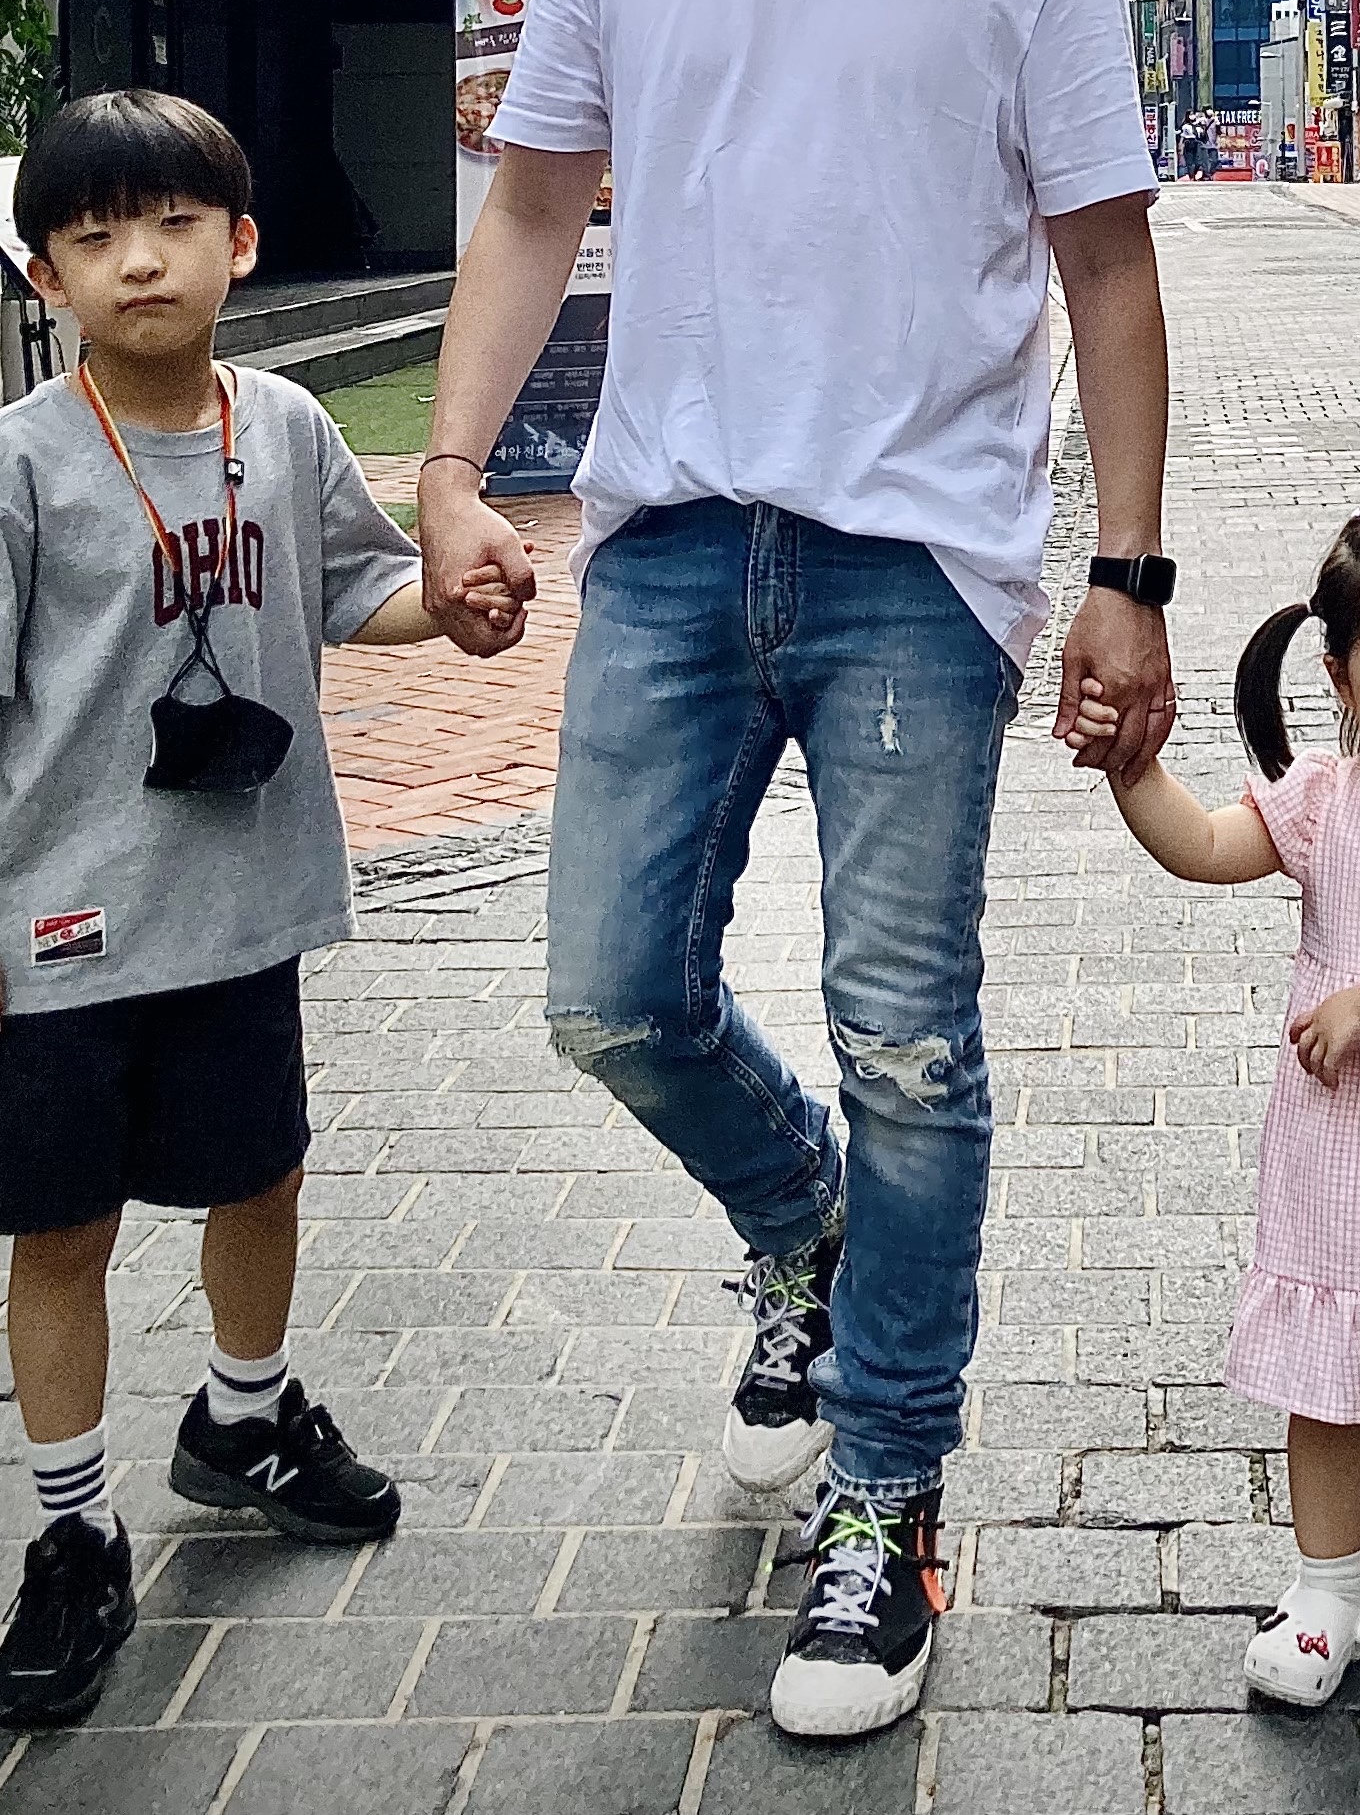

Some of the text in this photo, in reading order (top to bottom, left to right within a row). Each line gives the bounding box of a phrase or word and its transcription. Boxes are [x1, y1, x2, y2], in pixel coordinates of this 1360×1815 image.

[1220, 110, 1255, 124] TAX FREE
[576, 262, 604, 272] 반반전
[152, 518, 264, 628] OHIO
